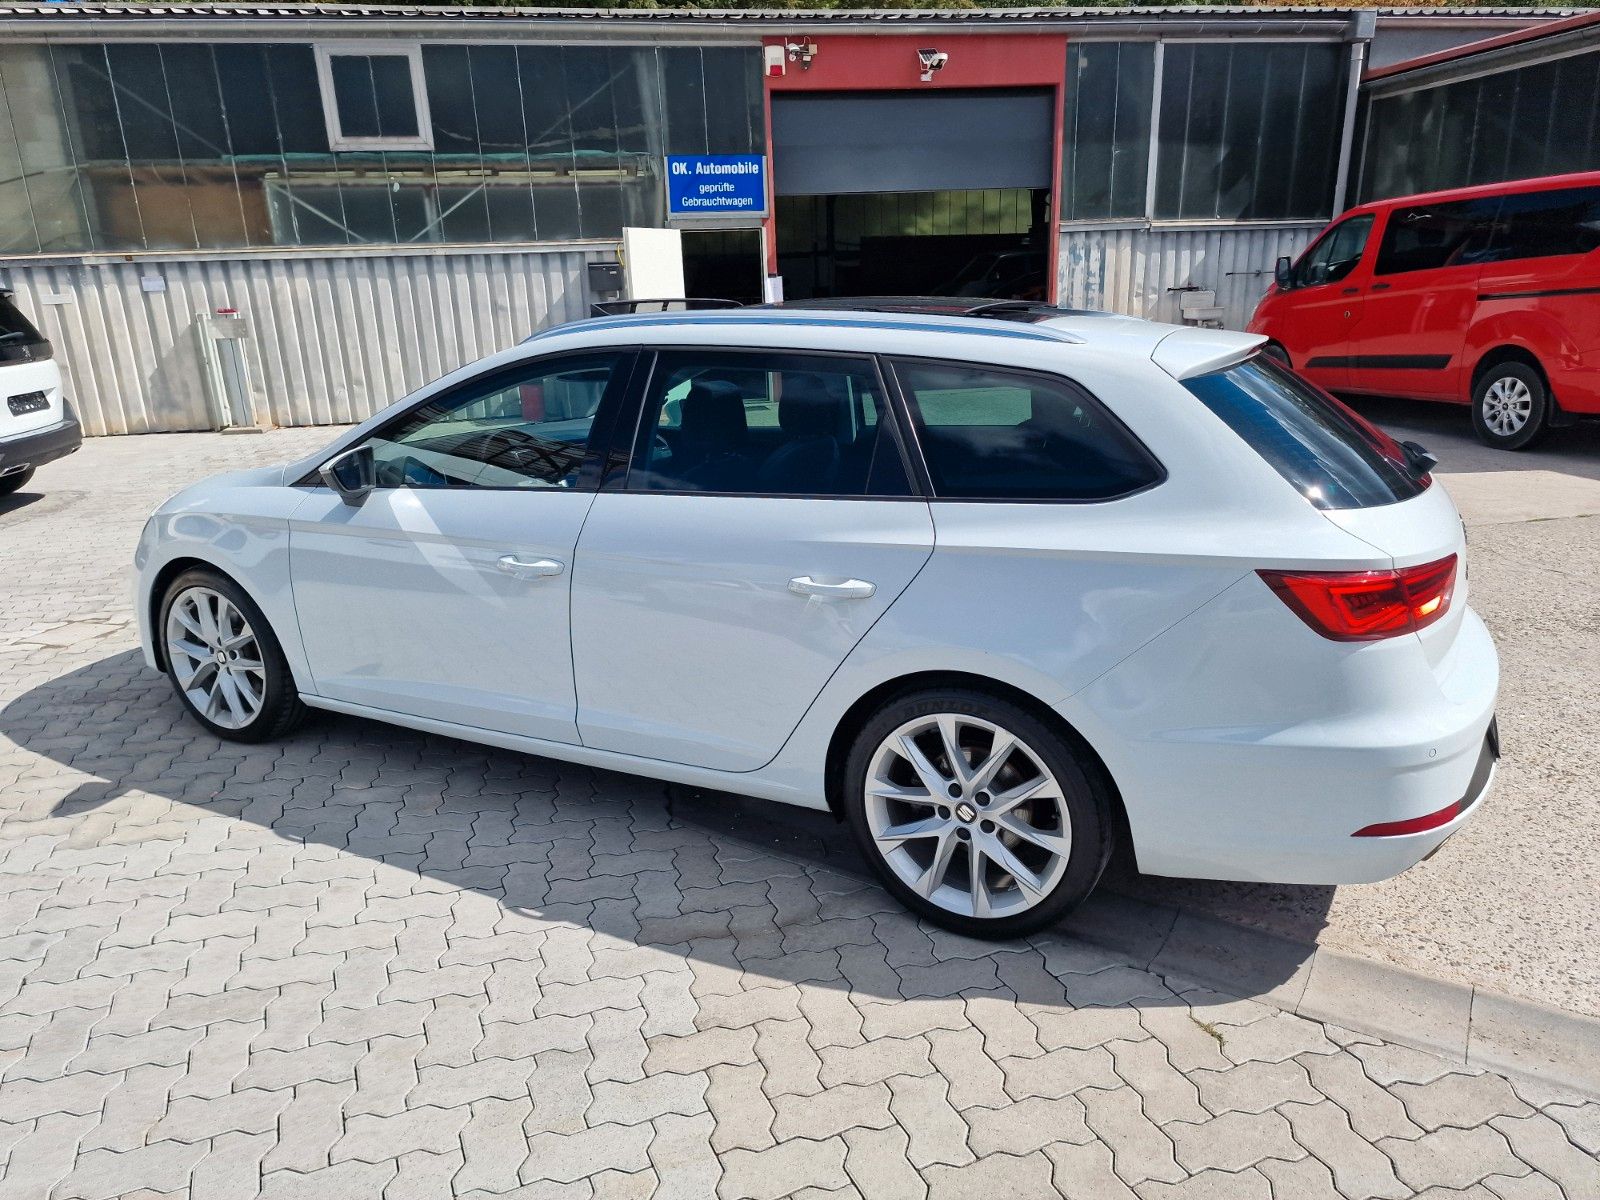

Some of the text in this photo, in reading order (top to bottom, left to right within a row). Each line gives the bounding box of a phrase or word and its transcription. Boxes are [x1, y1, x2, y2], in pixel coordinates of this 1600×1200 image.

[672, 162, 759, 175] OK. Automobile
[699, 182, 735, 194] geprüfte
[682, 197, 753, 207] Gebrauchtwagen
